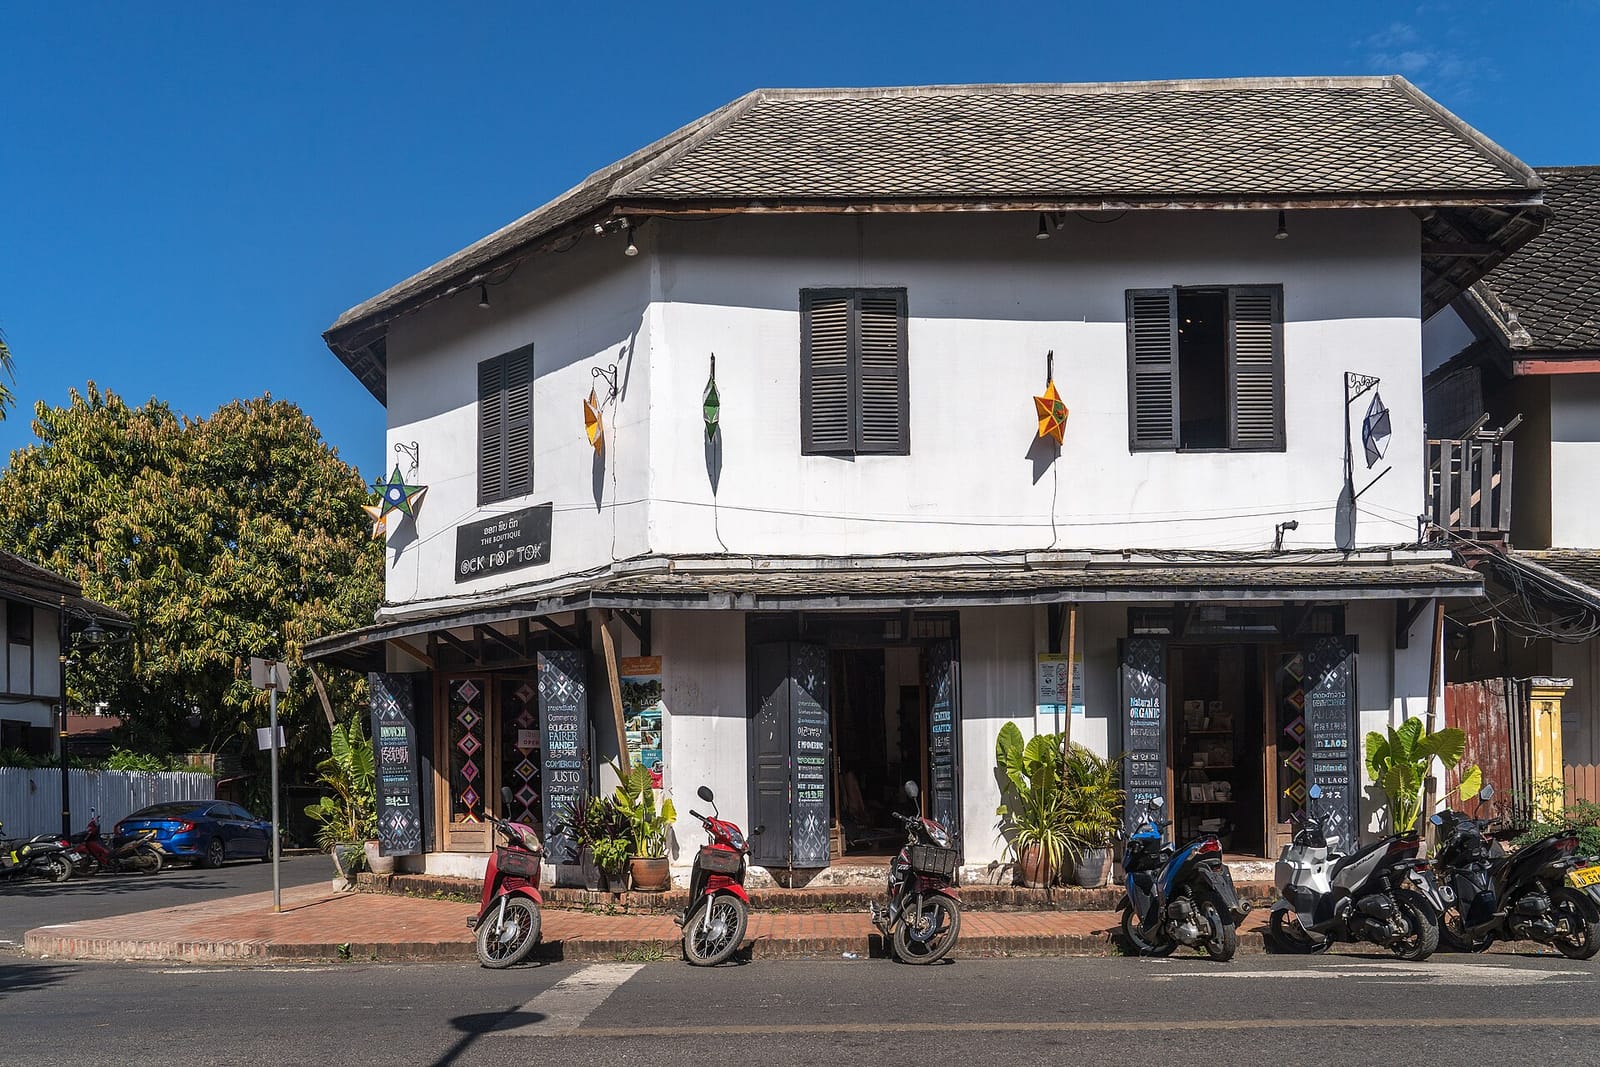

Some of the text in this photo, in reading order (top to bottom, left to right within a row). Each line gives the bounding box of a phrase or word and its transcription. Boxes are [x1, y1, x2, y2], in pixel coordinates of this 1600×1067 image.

[481, 529, 521, 546] THE BOUTIQUE
[460, 542, 542, 574] OCK POP TOK
[1129, 697, 1160, 708] Natural &
[547, 714, 578, 722] Commerce
[1129, 707, 1160, 719] ORGANIC
[549, 731, 578, 741] FAIRER
[549, 741, 578, 750] HANDEL
[1324, 739, 1348, 748] LAOS
[545, 760, 581, 768] COMERCIO
[1314, 763, 1348, 773] Handmade
[552, 770, 581, 783] JUSTO
